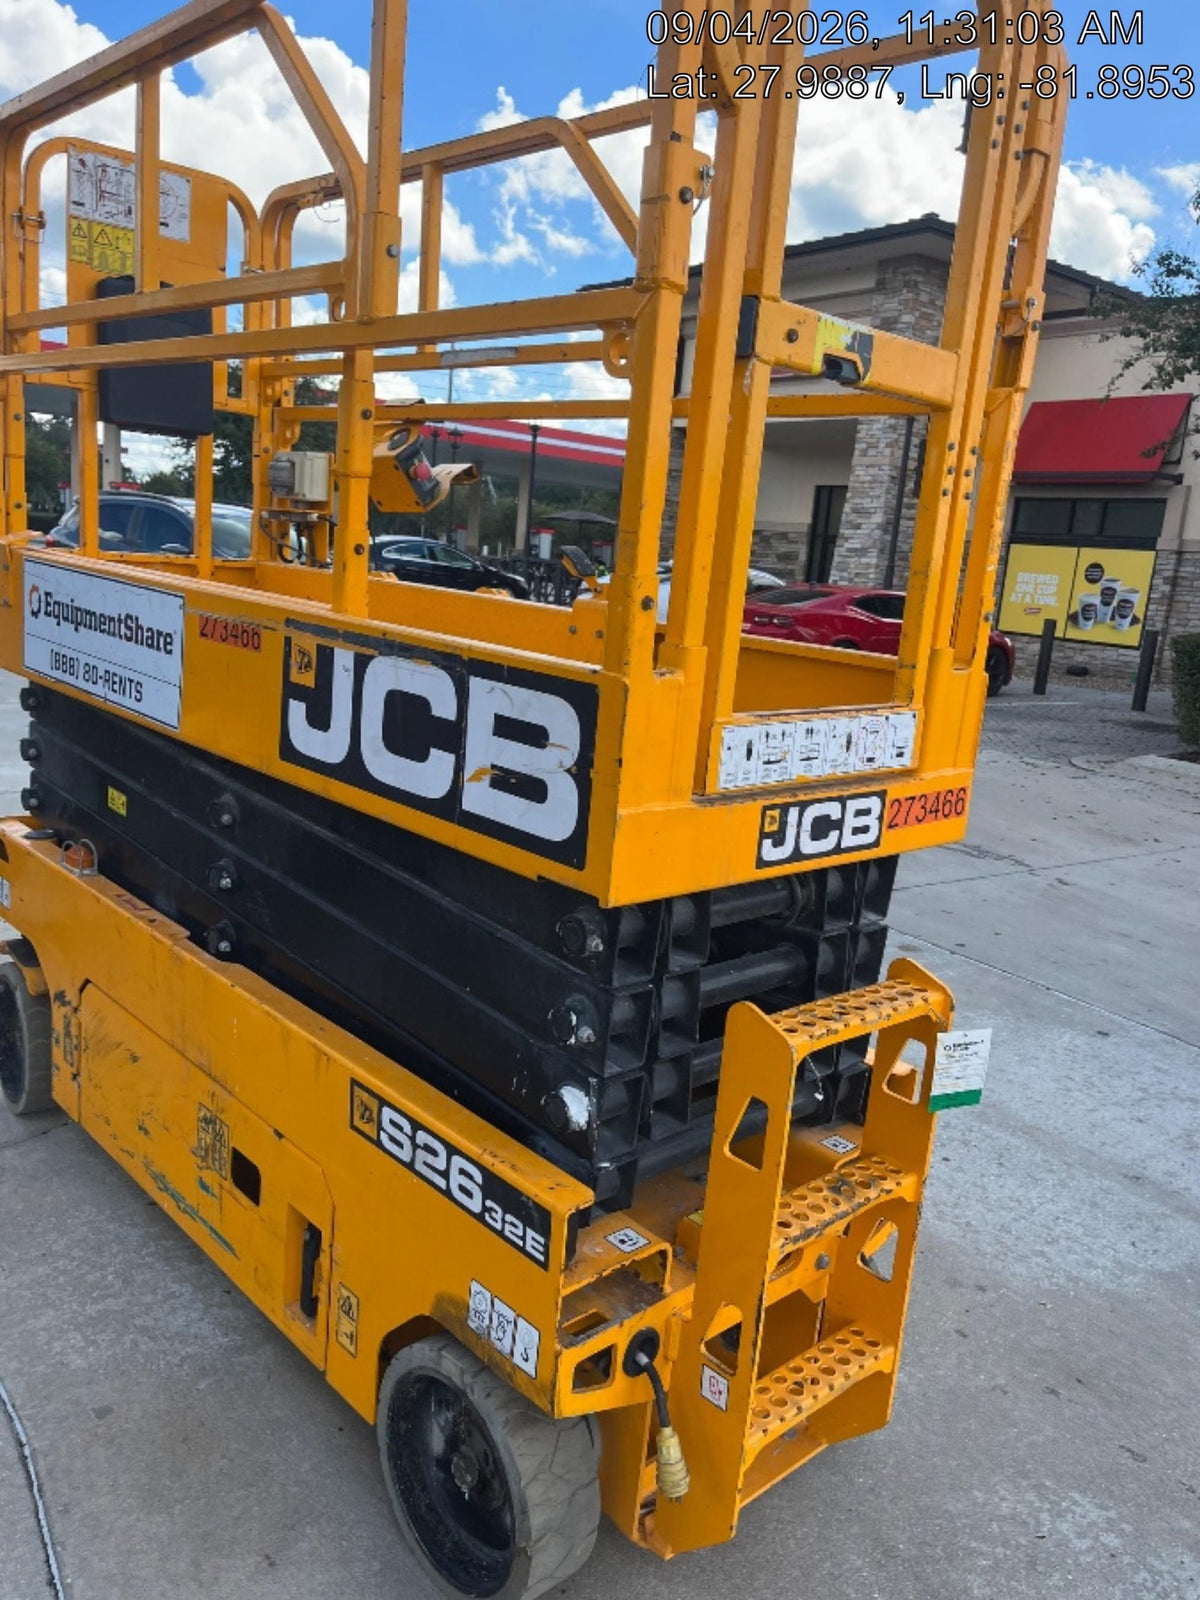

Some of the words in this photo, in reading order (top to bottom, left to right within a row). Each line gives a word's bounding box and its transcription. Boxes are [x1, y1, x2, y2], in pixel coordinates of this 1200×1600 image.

[43, 591, 174, 655] EquipmentShare
[199, 615, 261, 651] 273466
[50, 648, 80, 681] (888)
[82, 662, 143, 703] 80-RENTS
[288, 646, 581, 842] JCB
[760, 795, 882, 862] JCB
[886, 786, 968, 830] 273466
